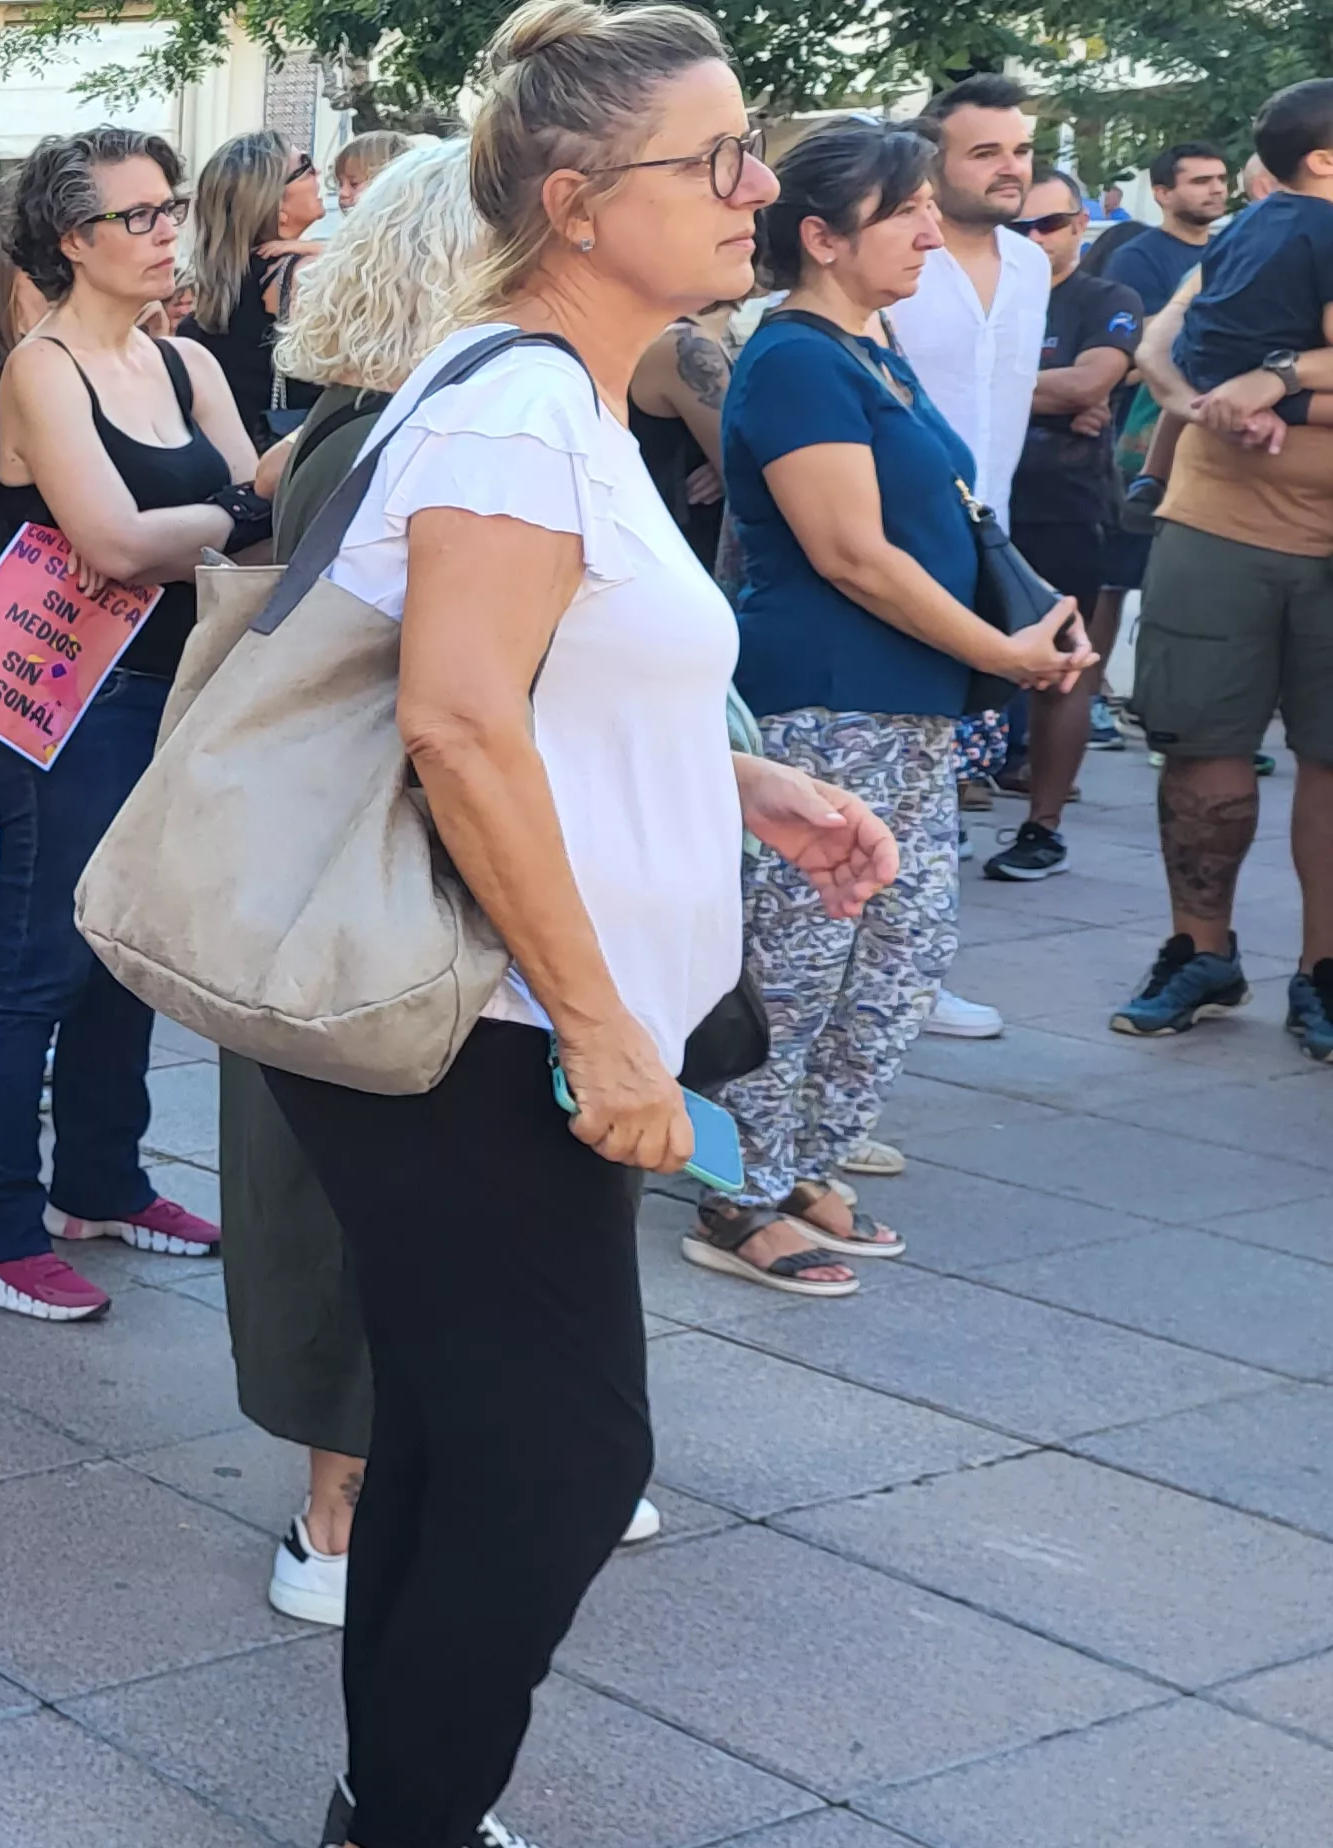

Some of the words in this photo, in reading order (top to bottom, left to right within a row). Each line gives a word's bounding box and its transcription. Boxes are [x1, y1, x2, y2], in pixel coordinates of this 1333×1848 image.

[11, 540, 42, 565] NO
[43, 590, 81, 624] SIN
[5, 602, 82, 661] MEDIOS
[2, 651, 44, 686] SIN
